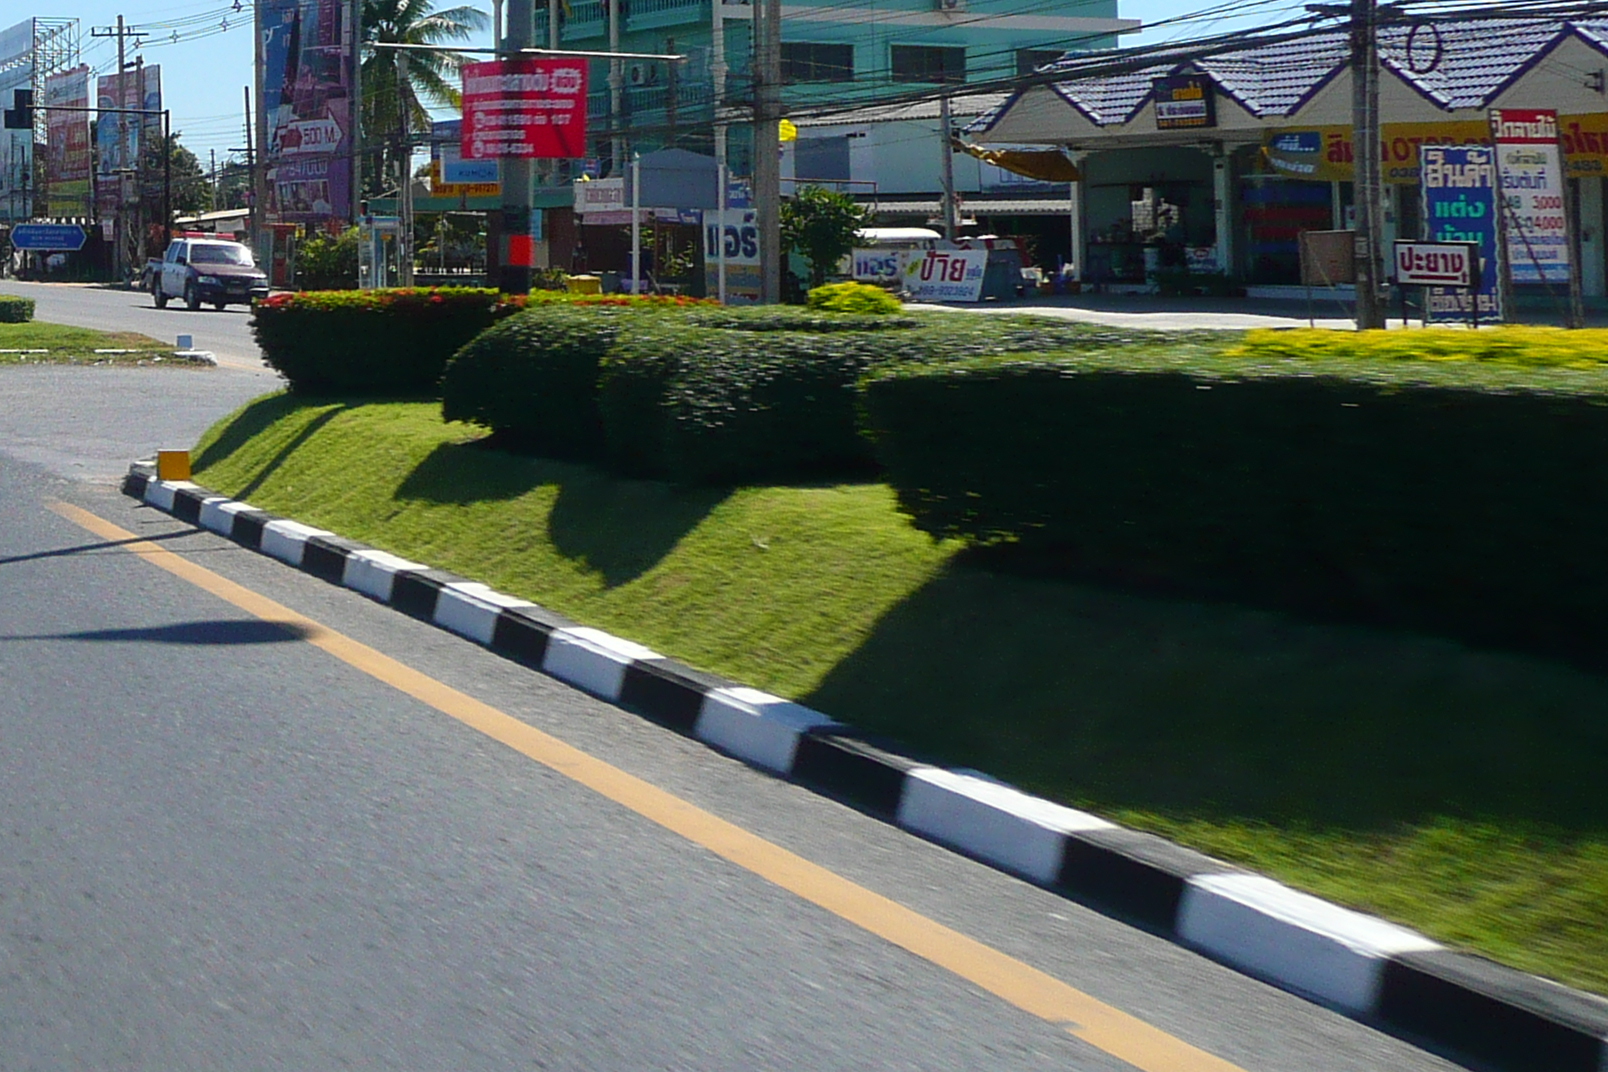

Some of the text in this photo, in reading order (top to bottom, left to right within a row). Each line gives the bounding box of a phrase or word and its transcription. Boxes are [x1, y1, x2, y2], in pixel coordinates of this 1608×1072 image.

[303, 127, 321, 145] 500
[1435, 194, 1486, 218] แต่ง
[1532, 196, 1562, 209] 3,000
[706, 212, 758, 258] แอร์
[1534, 216, 1564, 230] 4,000
[856, 251, 898, 276] แอร์
[920, 250, 967, 282] ป้าย
[1400, 246, 1464, 274] ปะยาง
